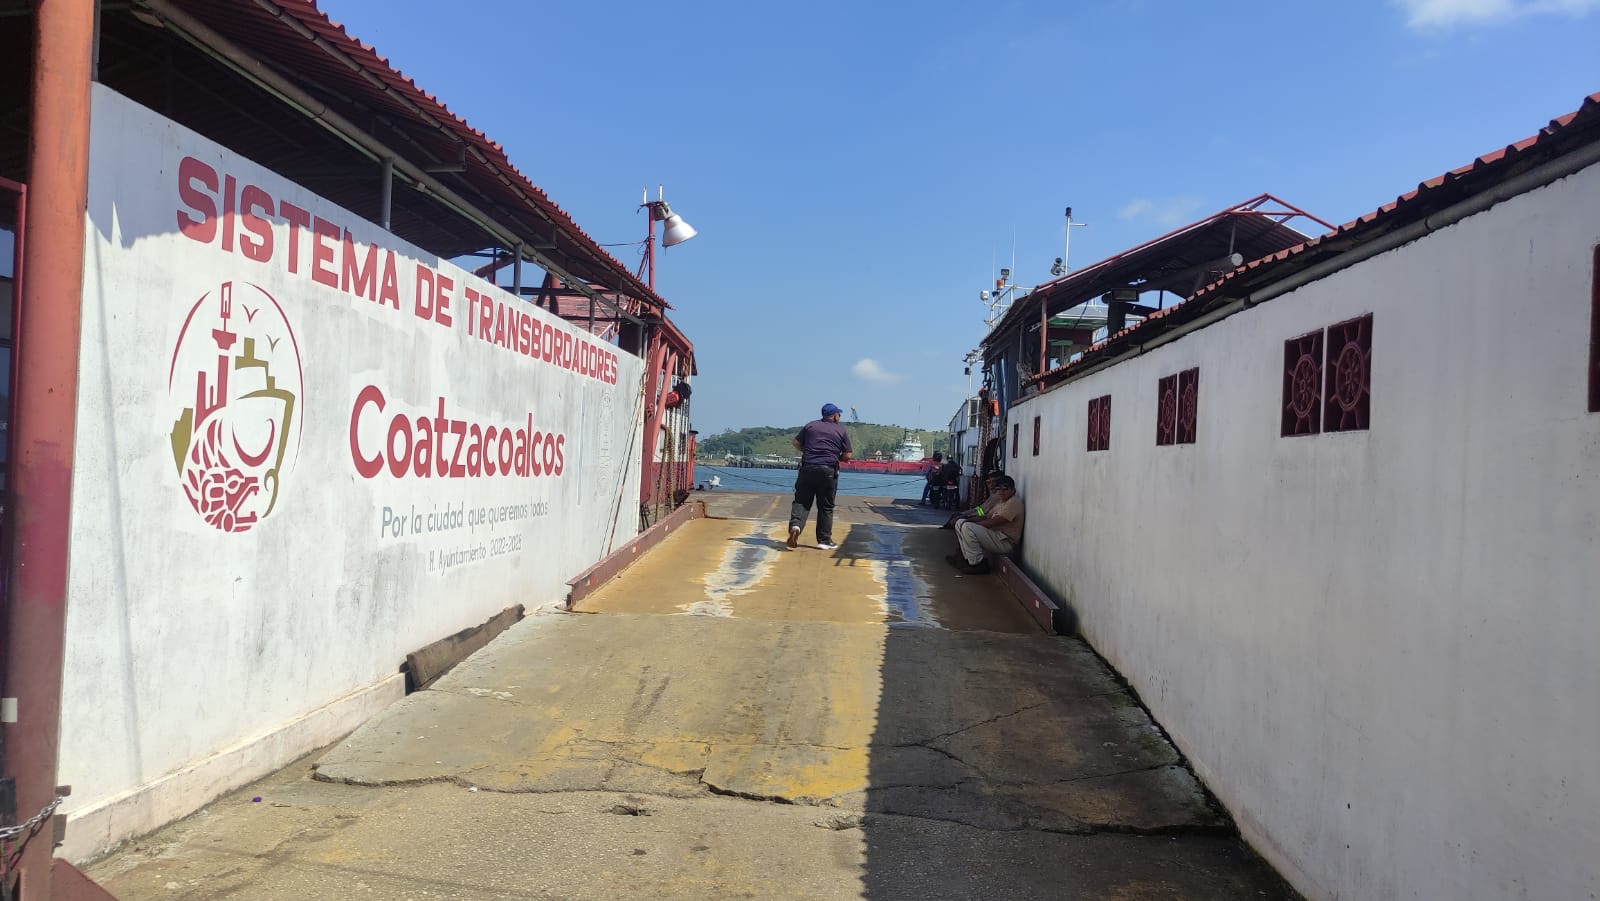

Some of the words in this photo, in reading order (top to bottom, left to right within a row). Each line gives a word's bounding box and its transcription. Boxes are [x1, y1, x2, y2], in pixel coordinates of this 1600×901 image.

[177, 155, 400, 310] SISTEMA
[415, 269, 453, 328] DE
[465, 286, 618, 386] TRANSBORDADORES
[349, 384, 565, 479] Coatzacoalcos
[381, 505, 408, 538] Por
[411, 504, 422, 534] la
[427, 501, 464, 532] ciudad
[468, 506, 485, 534] que
[488, 503, 528, 531] queremos
[429, 550, 436, 571] H.
[438, 543, 486, 576] Ayuntamiento
